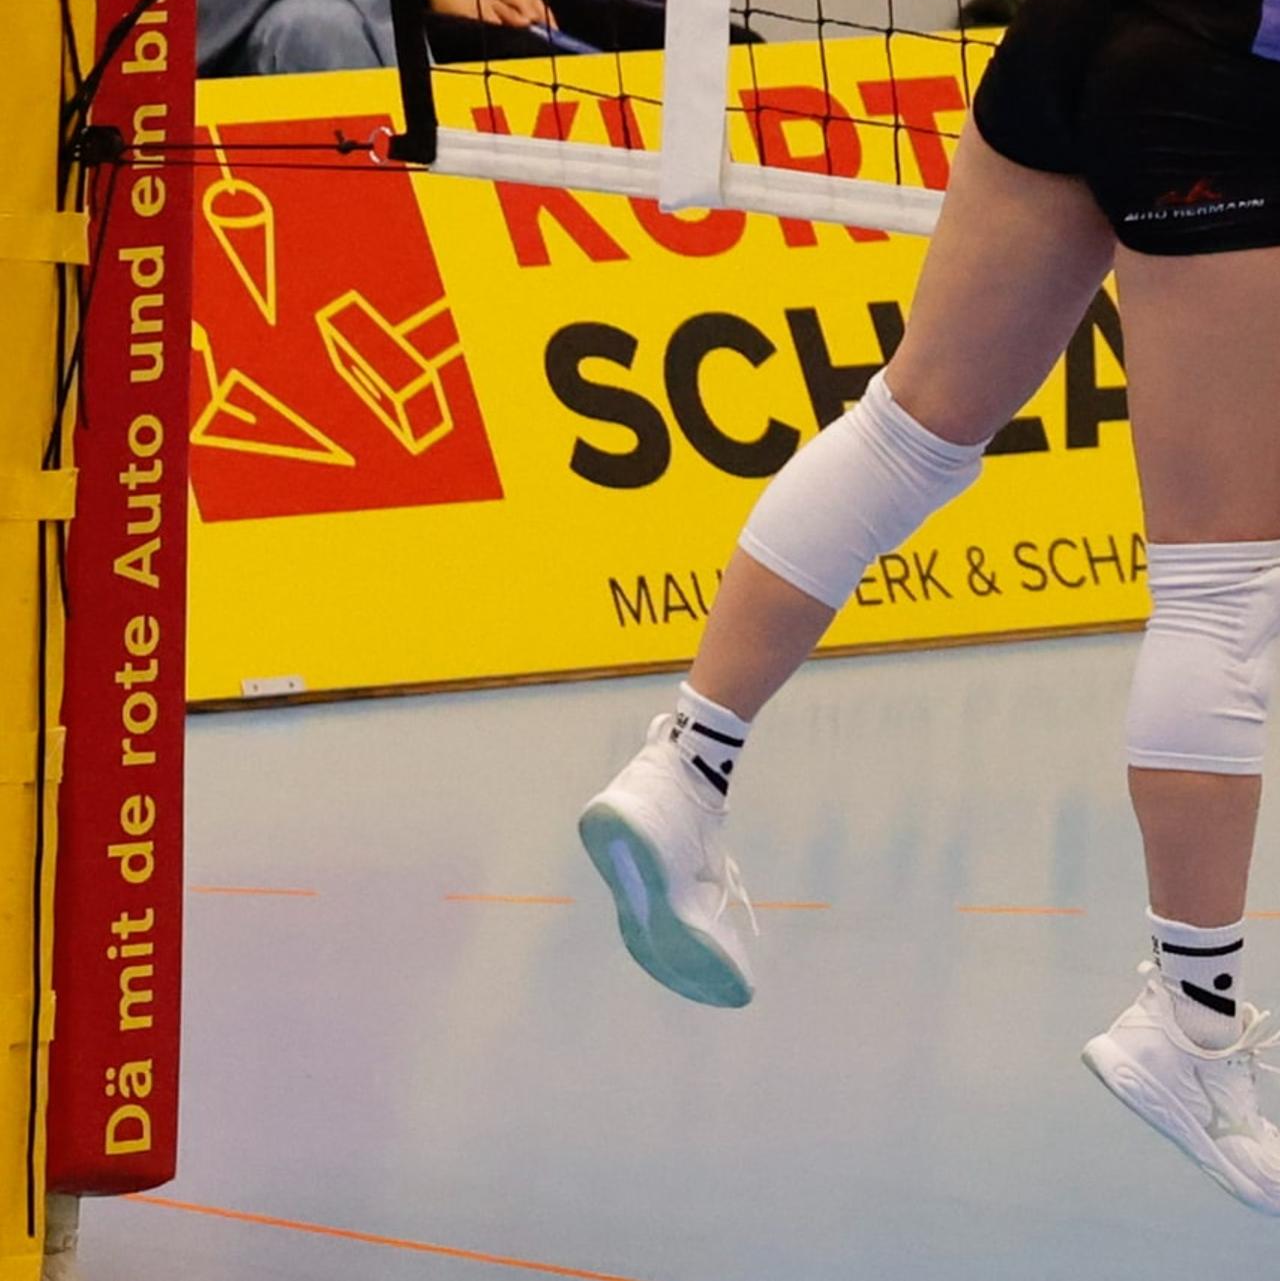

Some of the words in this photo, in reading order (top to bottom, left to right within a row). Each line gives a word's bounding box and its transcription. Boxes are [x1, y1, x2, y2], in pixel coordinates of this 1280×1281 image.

[131, 103, 167, 218] em
[471, 76, 968, 268] KURT
[118, 243, 166, 384] und
[114, 420, 165, 590] Auto
[965, 544, 1001, 597] &
[115, 615, 160, 766] rote
[107, 794, 156, 884] de
[107, 907, 153, 1031] mit
[105, 1058, 152, 1156] Dä
